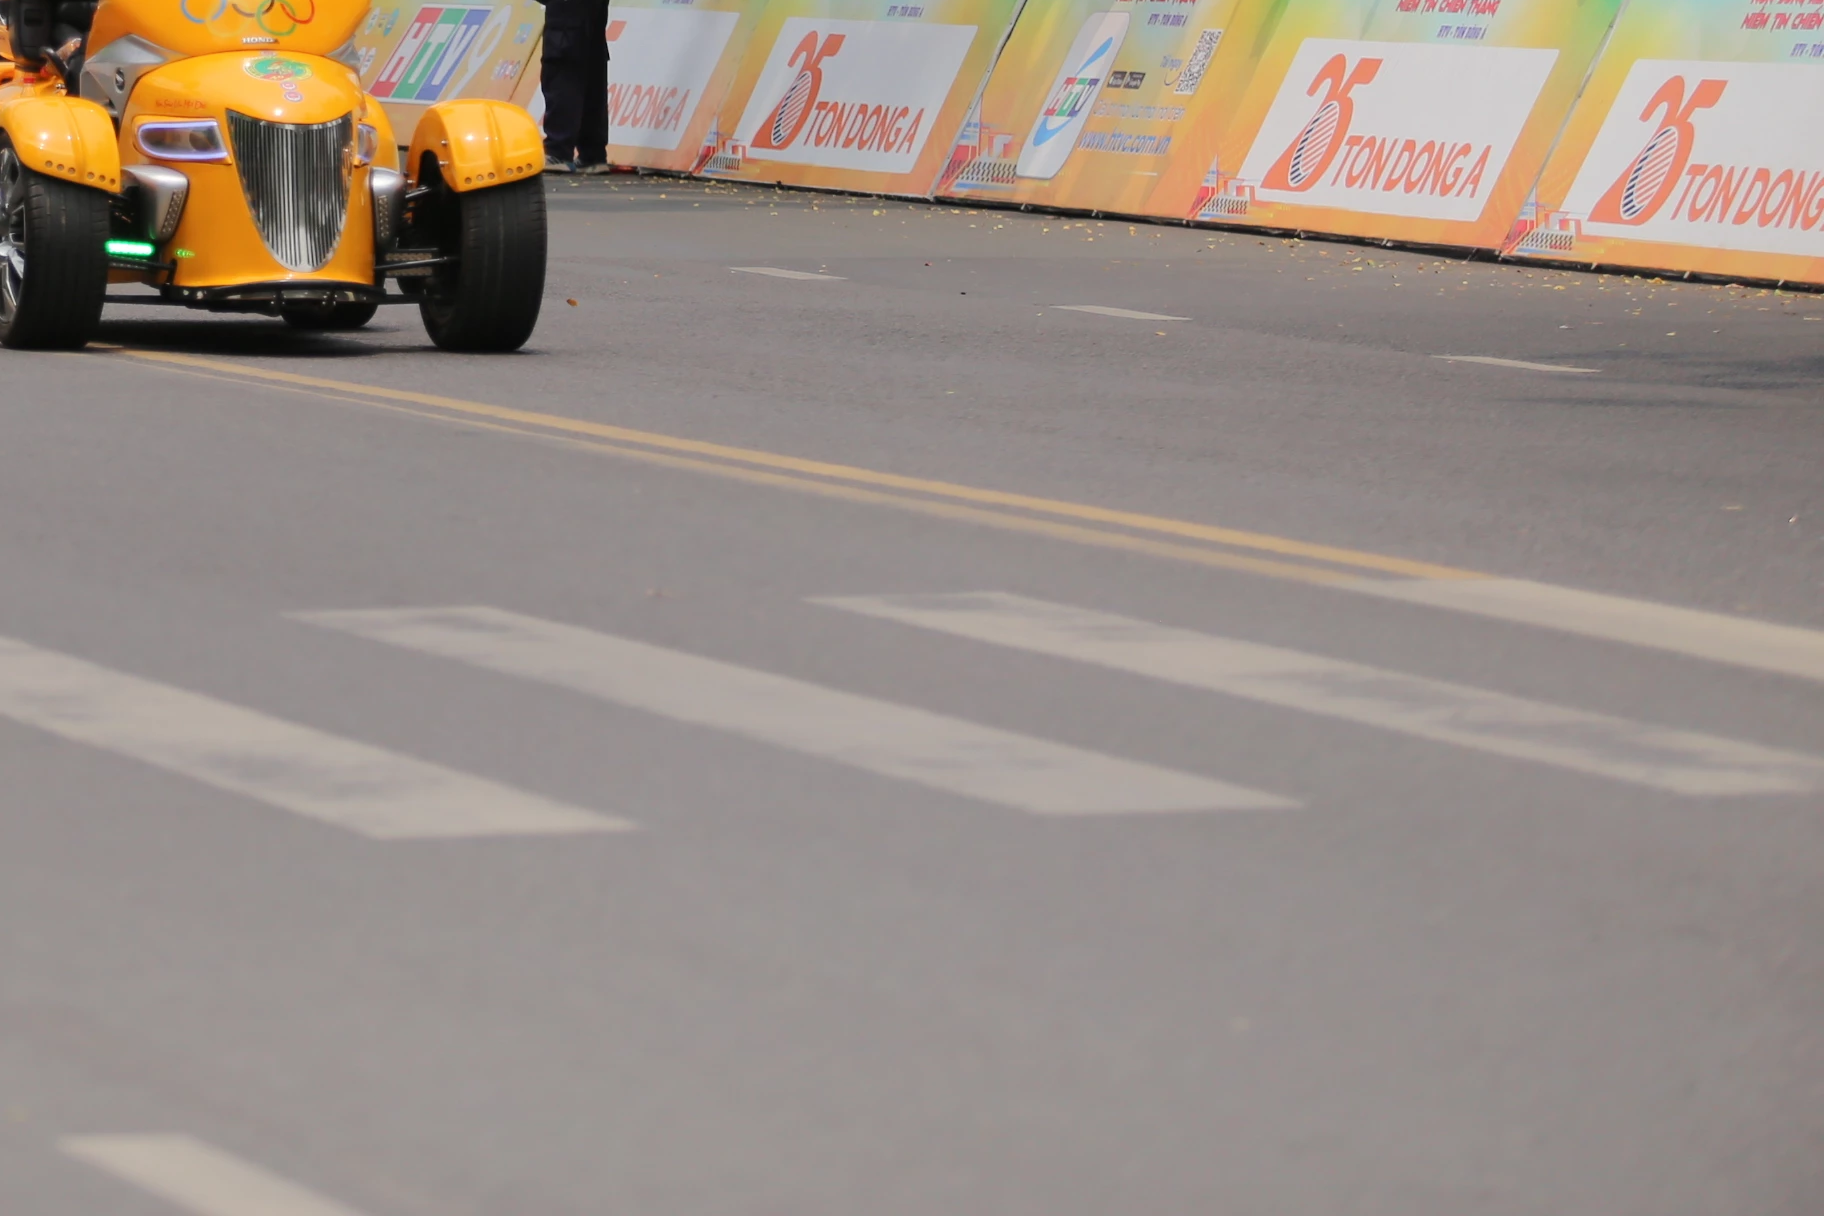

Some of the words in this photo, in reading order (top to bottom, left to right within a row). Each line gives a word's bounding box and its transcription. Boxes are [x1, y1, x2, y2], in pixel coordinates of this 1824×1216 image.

[620, 83, 677, 130] DONG
[664, 88, 691, 132] A
[750, 30, 846, 151] 25
[804, 100, 849, 148] TON
[842, 103, 903, 154] DONG
[885, 108, 925, 154] A
[1259, 53, 1383, 193] 25
[1330, 134, 1386, 189] TON
[1382, 139, 1473, 198] DONG
[1454, 144, 1492, 199] A
[1586, 74, 1729, 226] 25
[1670, 162, 1749, 224] TON
